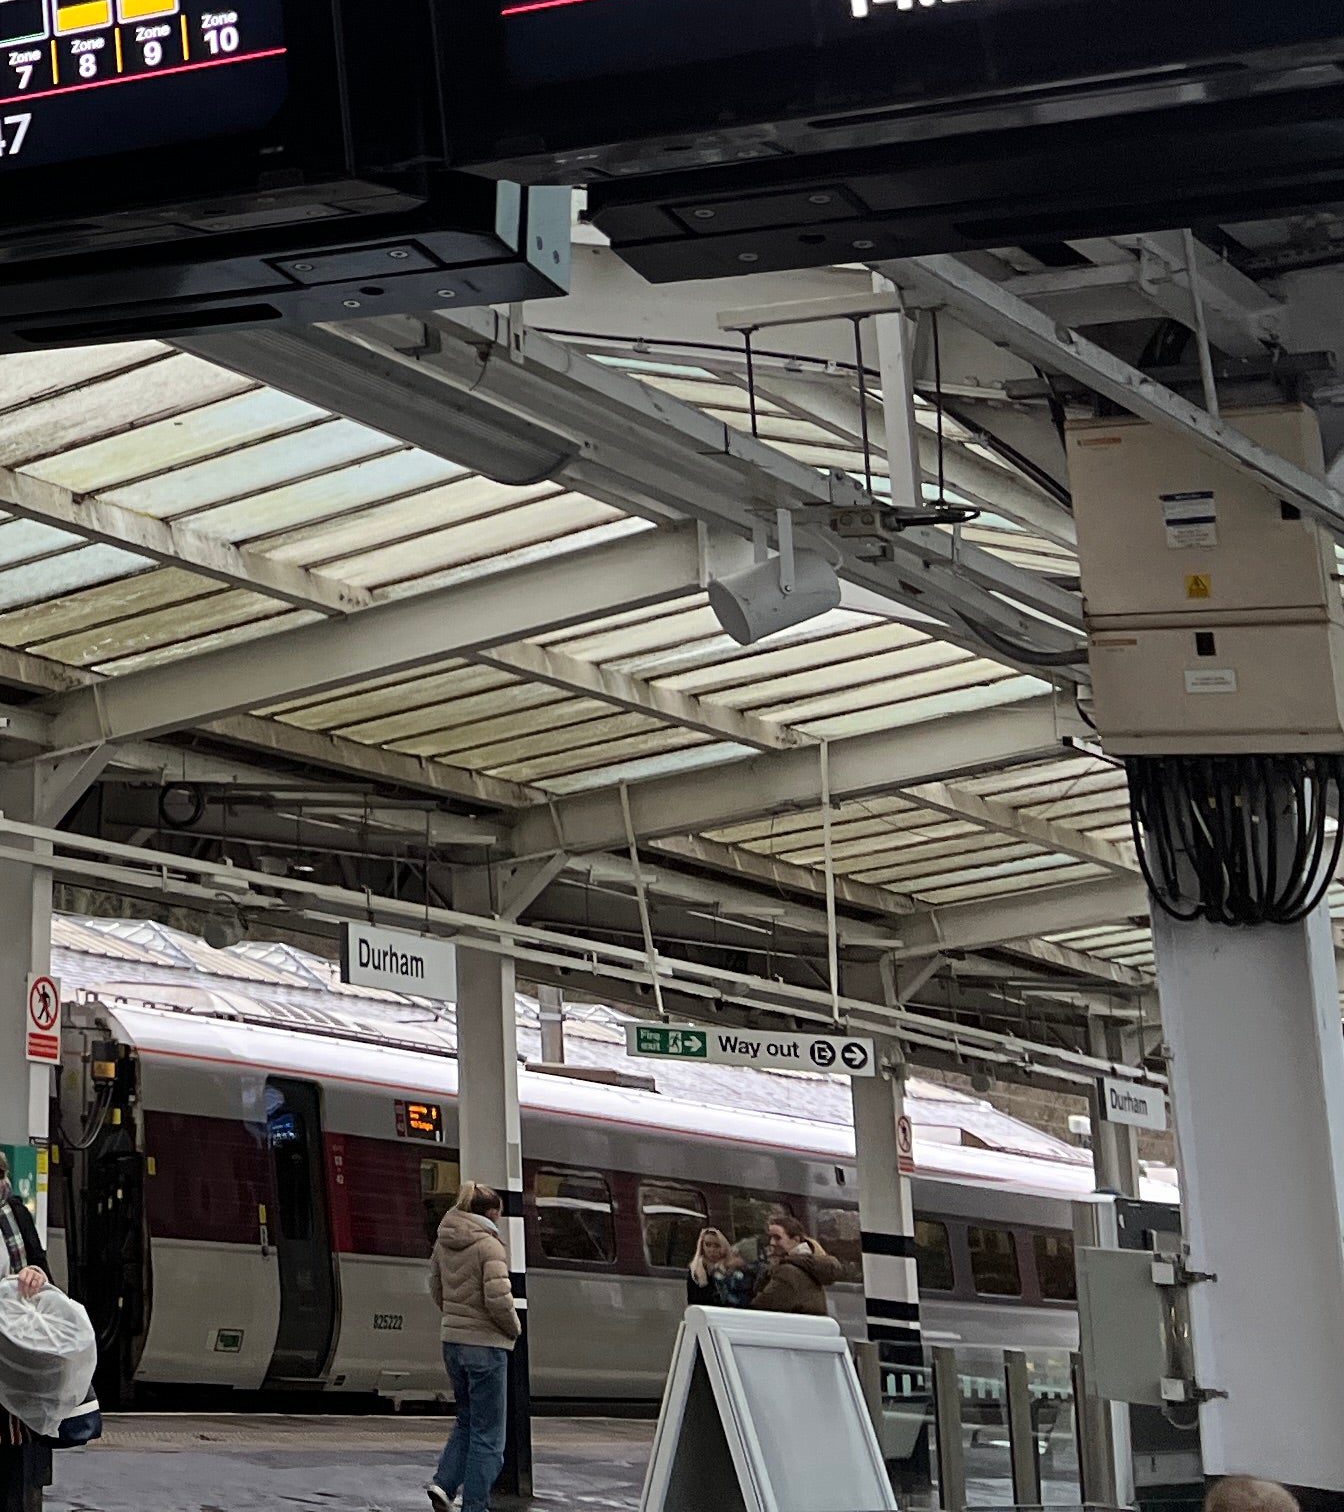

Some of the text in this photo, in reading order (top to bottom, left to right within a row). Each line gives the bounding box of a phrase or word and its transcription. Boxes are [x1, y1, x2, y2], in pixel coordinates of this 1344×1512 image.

[359, 938, 424, 978] Durham
[719, 1036, 799, 1058] Way out
[1111, 1088, 1147, 1115] Durham
